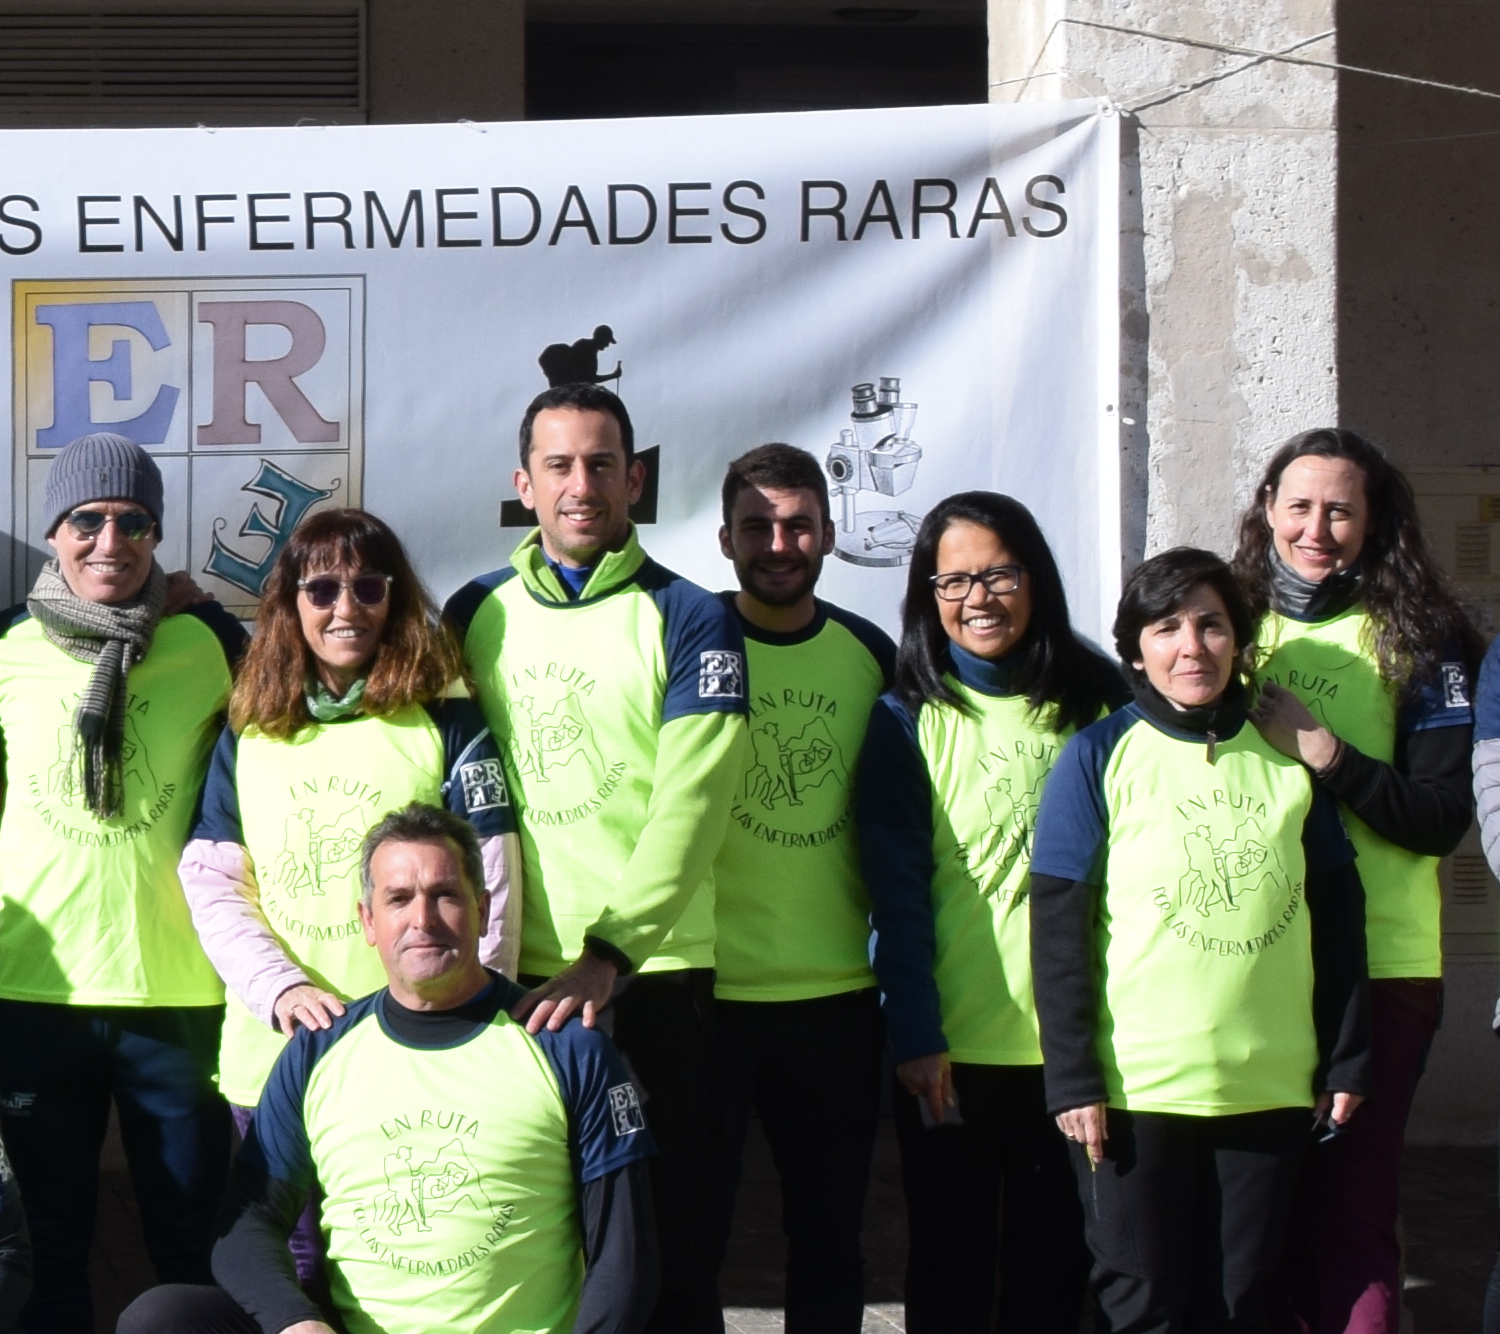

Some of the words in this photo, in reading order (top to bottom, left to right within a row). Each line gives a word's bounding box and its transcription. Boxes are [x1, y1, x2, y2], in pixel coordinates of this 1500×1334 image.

[78, 179, 768, 255] ENFERMEDADES
[799, 173, 1070, 243] RARAS
[35, 300, 340, 448] ER
[545, 661, 597, 697] RUTA
[1289, 670, 1340, 701] RUTA
[783, 688, 838, 718] RUTA
[977, 745, 1009, 774] EN
[1015, 740, 1057, 763] RUT
[289, 780, 318, 801] EN
[328, 775, 383, 808] RUTA
[598, 759, 628, 803] RARAS
[149, 781, 177, 824] RARAS
[730, 804, 756, 830] LAS
[1176, 795, 1207, 821] EN
[1213, 789, 1267, 819] RUTA
[1150, 886, 1172, 913] POR
[1163, 912, 1192, 939] LAS
[1189, 922, 1286, 957] ENFERMEDADES
[1285, 880, 1304, 924] RARAS
[380, 1112, 413, 1141] EN
[420, 1109, 480, 1141] RUTA
[360, 1227, 382, 1254] LAS
[380, 1242, 491, 1276] ENFERMEDADES
[486, 1201, 516, 1249] RARAS
